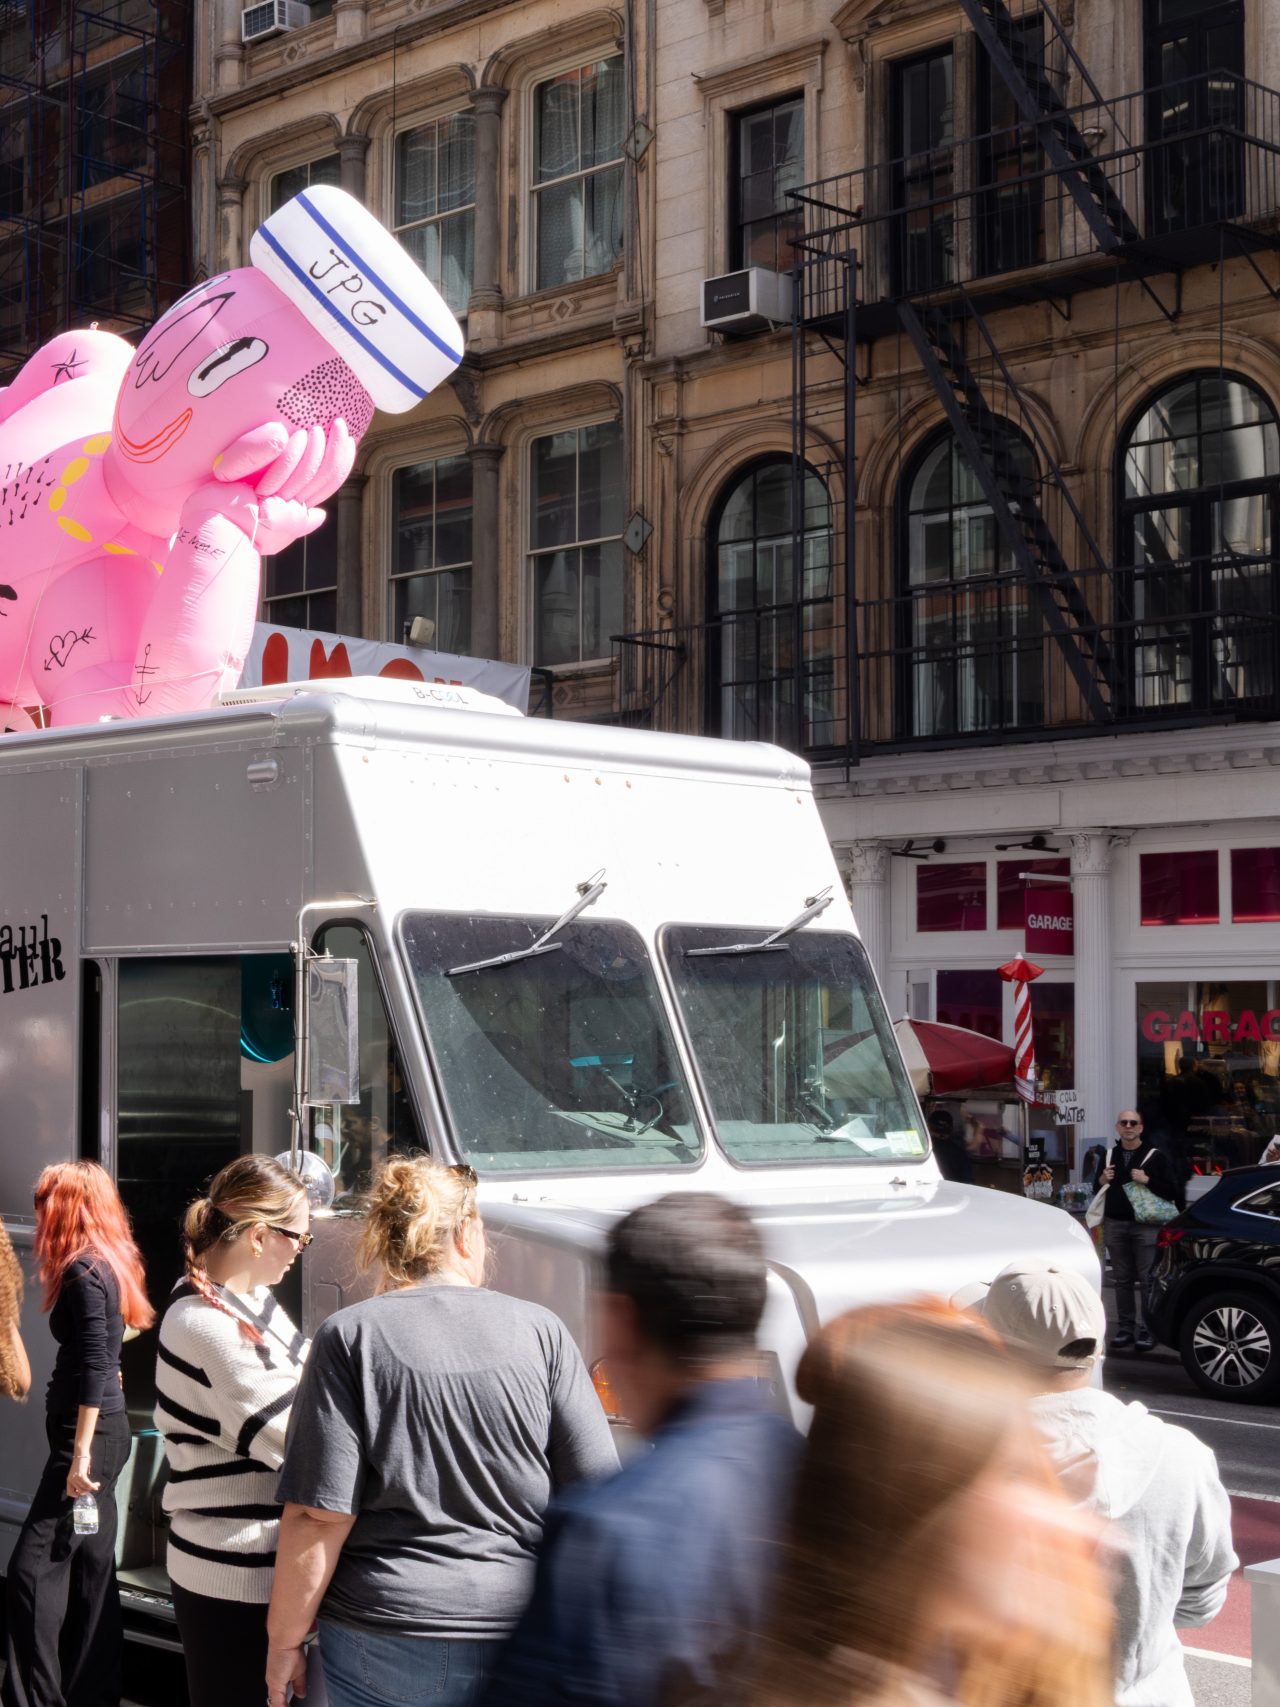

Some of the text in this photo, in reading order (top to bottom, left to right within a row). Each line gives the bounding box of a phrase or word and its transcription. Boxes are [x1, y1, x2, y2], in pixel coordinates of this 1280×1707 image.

[308, 248, 387, 326] JPG
[1028, 914, 1073, 931] GARAGE
[1141, 1010, 1280, 1043] GARAG
[1060, 1091, 1077, 1103] COLD
[1057, 1105, 1086, 1123] WATER
